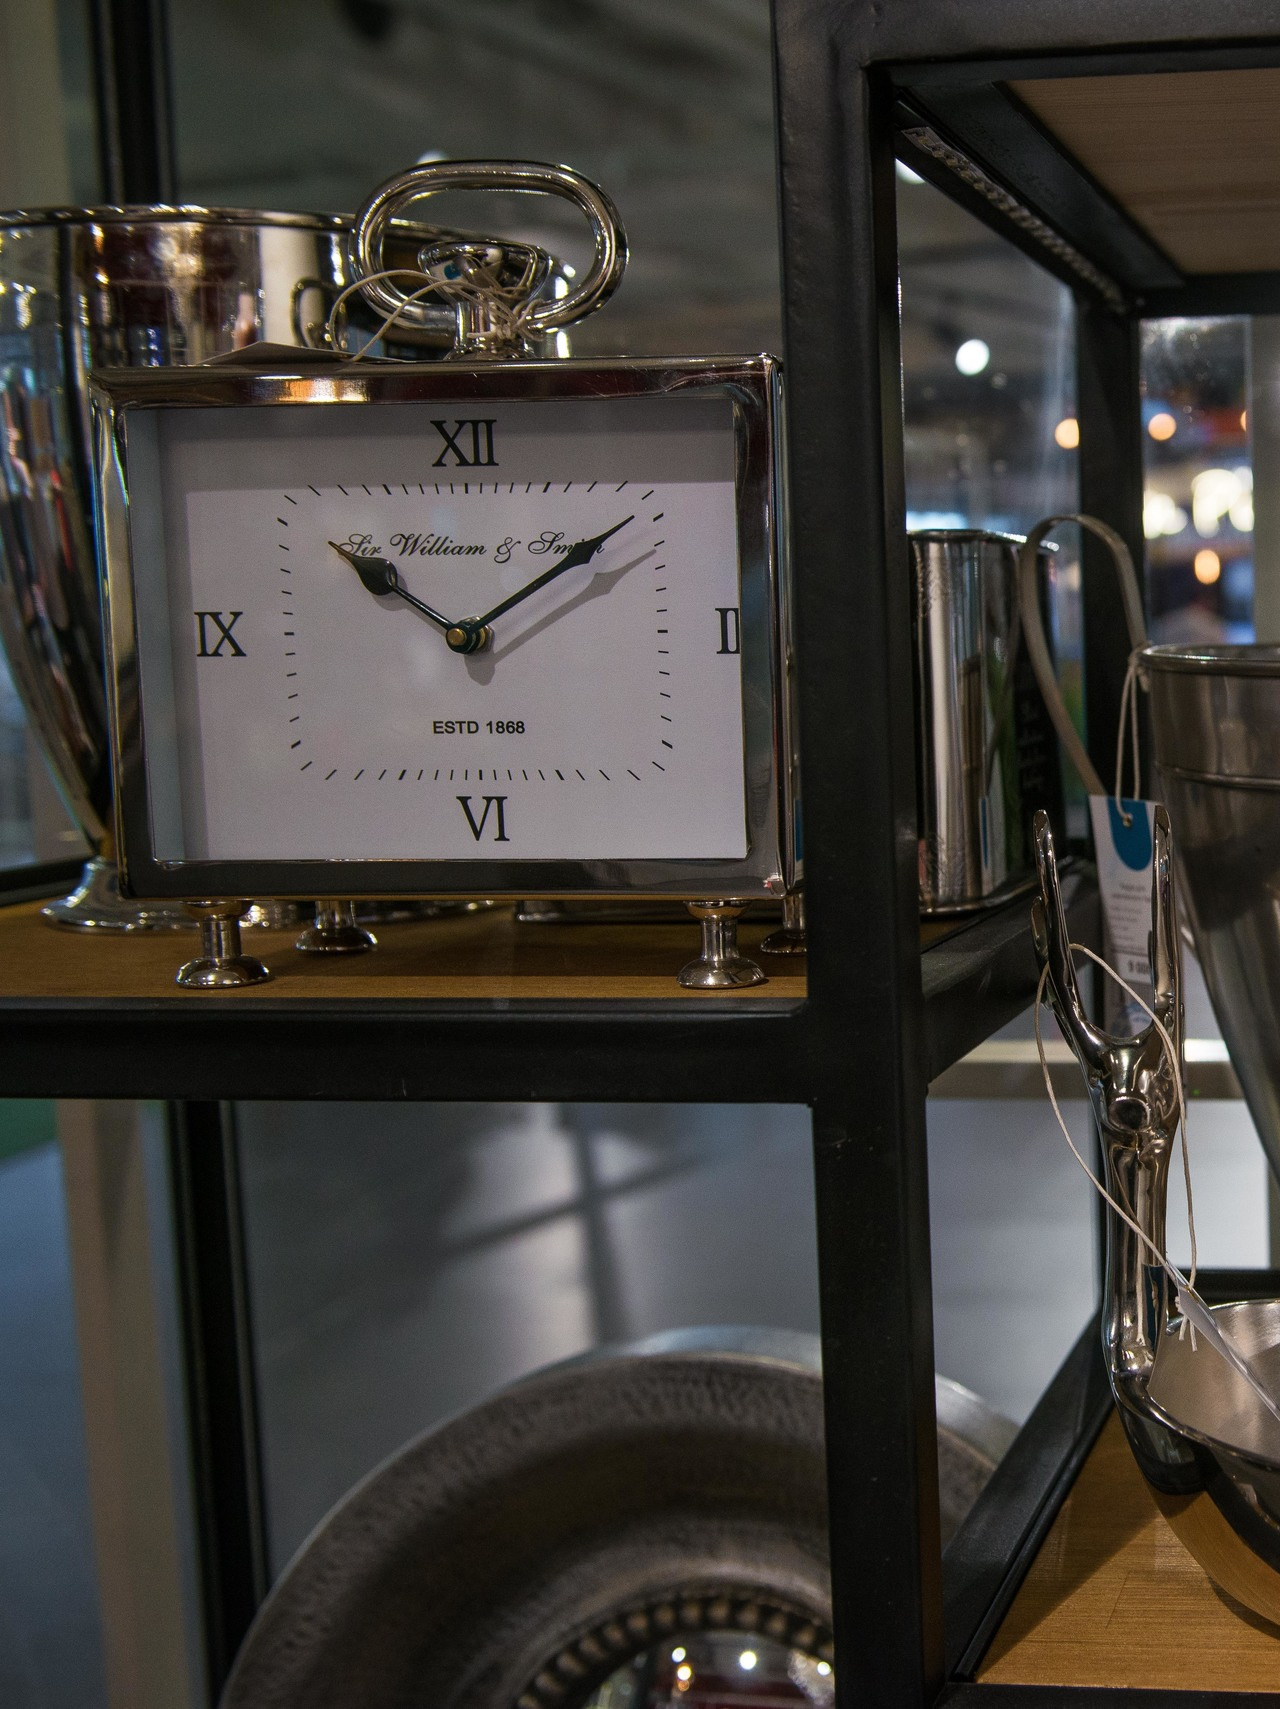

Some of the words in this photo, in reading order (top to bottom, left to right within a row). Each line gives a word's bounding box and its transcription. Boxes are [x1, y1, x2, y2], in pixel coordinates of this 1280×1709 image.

[430, 418, 500, 468] XII
[390, 533, 487, 556] William
[494, 536, 522, 564] &
[194, 611, 247, 657] IX
[432, 720, 480, 735] ESTD
[486, 719, 526, 735] 1868
[456, 796, 511, 842] VI
